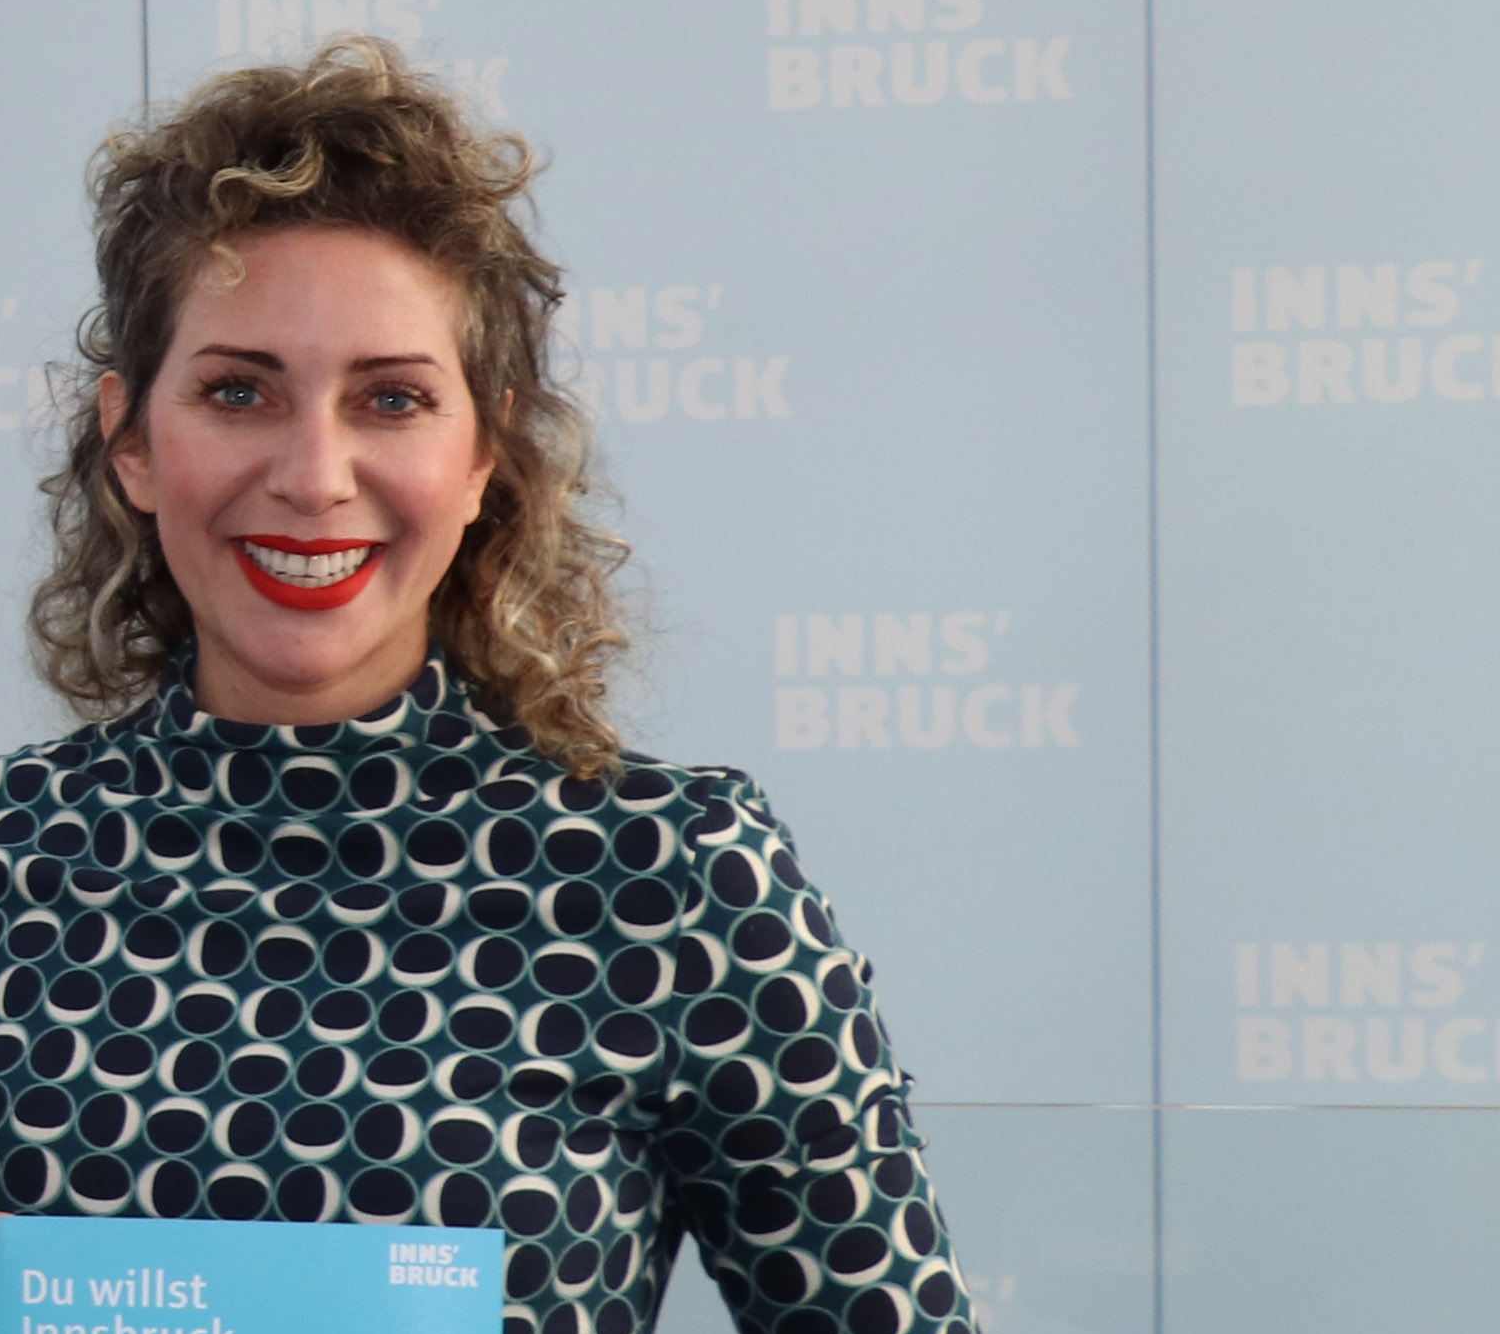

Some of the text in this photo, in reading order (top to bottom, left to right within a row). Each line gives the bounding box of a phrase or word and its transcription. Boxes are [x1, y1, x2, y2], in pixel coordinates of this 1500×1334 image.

[767, 36, 1077, 111] BRUCK
[1231, 259, 1484, 332] INNS'
[1231, 334, 1500, 408] BRUC
[775, 610, 1012, 677] INNS'
[775, 683, 1082, 751] BRUCK
[1233, 941, 1485, 1008] INNS'
[1233, 1016, 1500, 1083] BRUC
[389, 1243, 459, 1265] INNS'
[389, 1265, 479, 1288] BRUCK
[22, 1268, 208, 1309] Du willst
